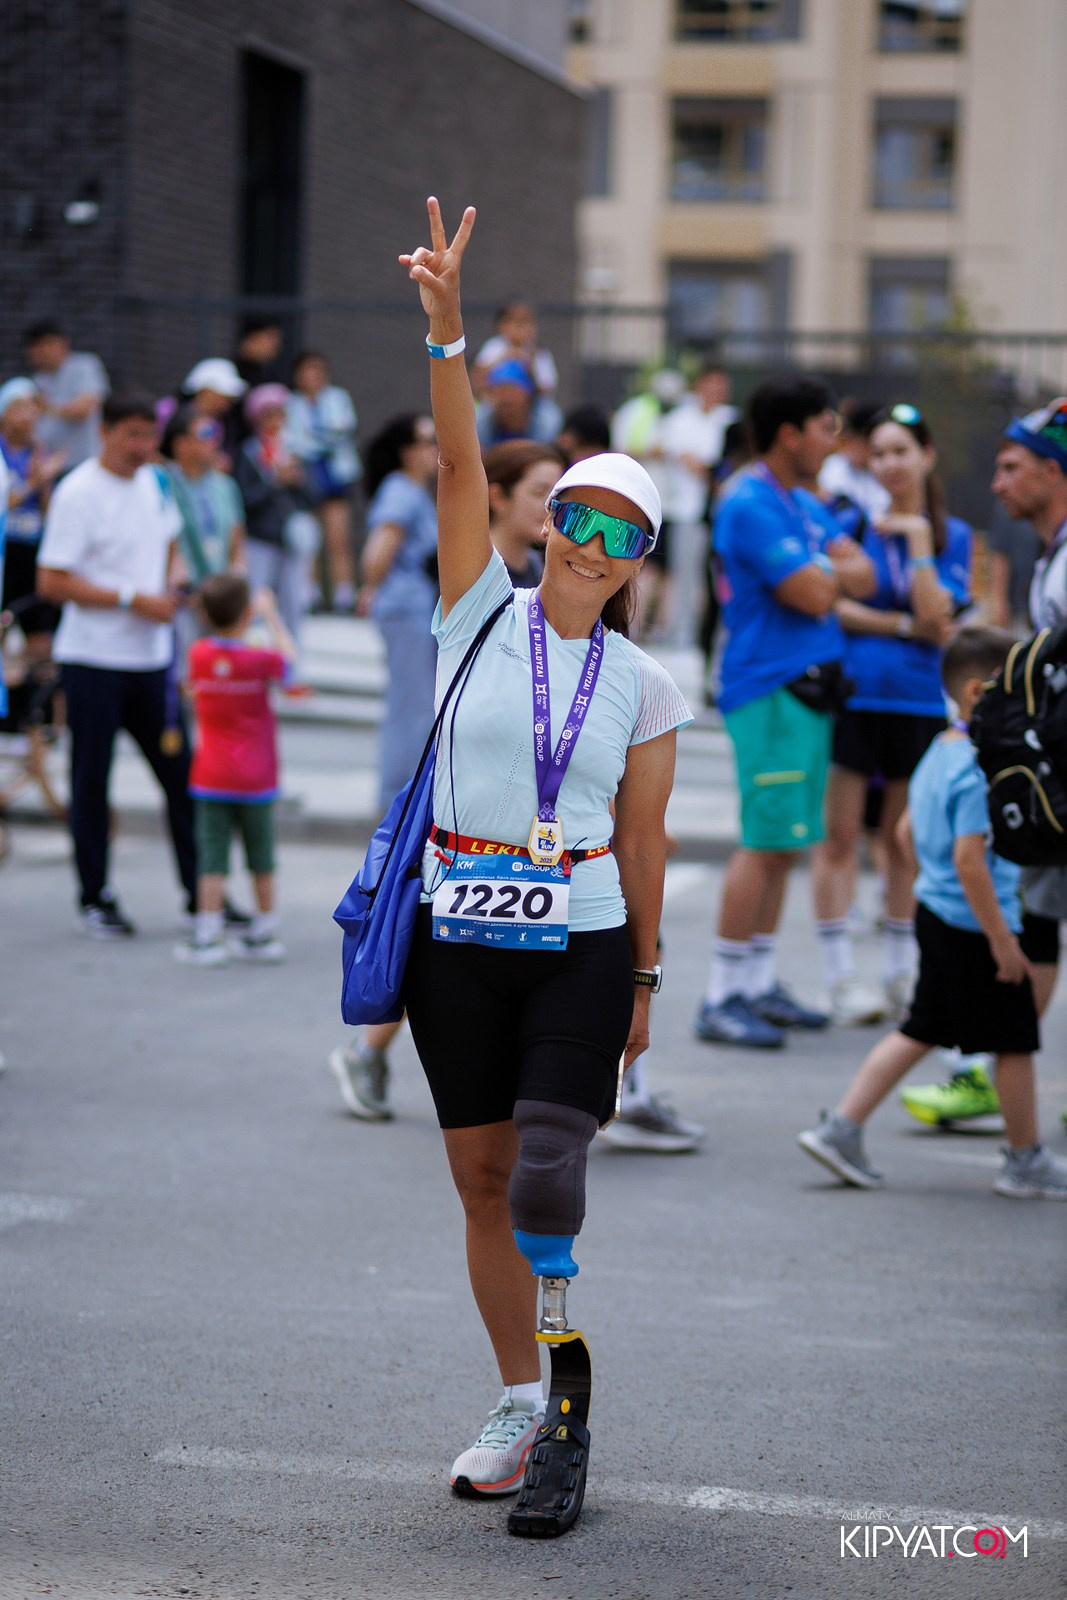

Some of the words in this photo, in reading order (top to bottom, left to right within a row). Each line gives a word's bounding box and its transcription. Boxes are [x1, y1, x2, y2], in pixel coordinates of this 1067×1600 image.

[530, 605, 539, 618] City
[534, 633, 542, 641] BI
[534, 642, 544, 678] JULDYZAI
[592, 651, 599, 660] BI
[583, 660, 597, 690] JULDYZAI
[578, 706, 586, 719] Arena
[555, 740, 567, 766] GROUP
[470, 842, 520, 856] LEKI
[456, 860, 474, 870] KM
[524, 864, 550, 872] GROUP
[448, 884, 553, 920] 1220
